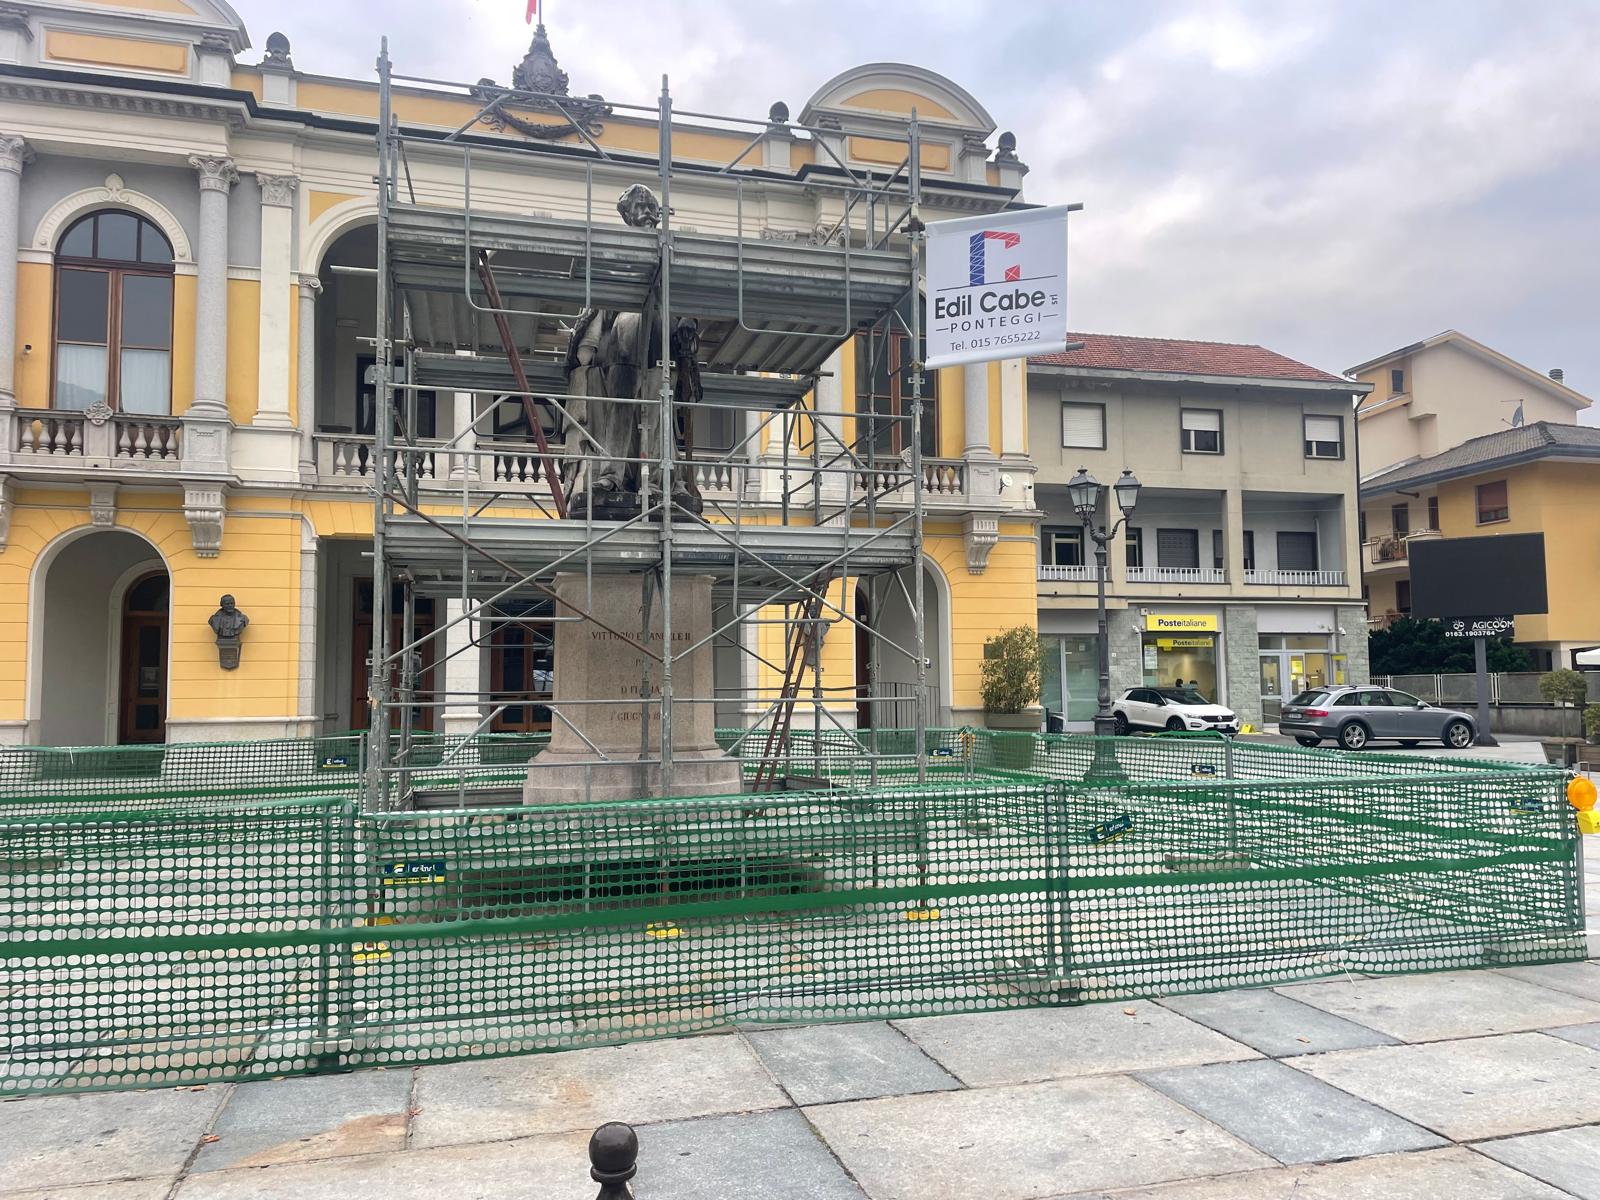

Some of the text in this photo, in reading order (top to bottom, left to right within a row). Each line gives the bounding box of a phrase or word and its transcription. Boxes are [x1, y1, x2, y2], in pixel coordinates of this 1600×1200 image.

[935, 289, 1046, 320] Edil Cabe
[950, 312, 1041, 333] PONTEGGI
[950, 330, 1041, 351] Tel. 015 7655222
[1158, 618, 1207, 627] Posteitaliane
